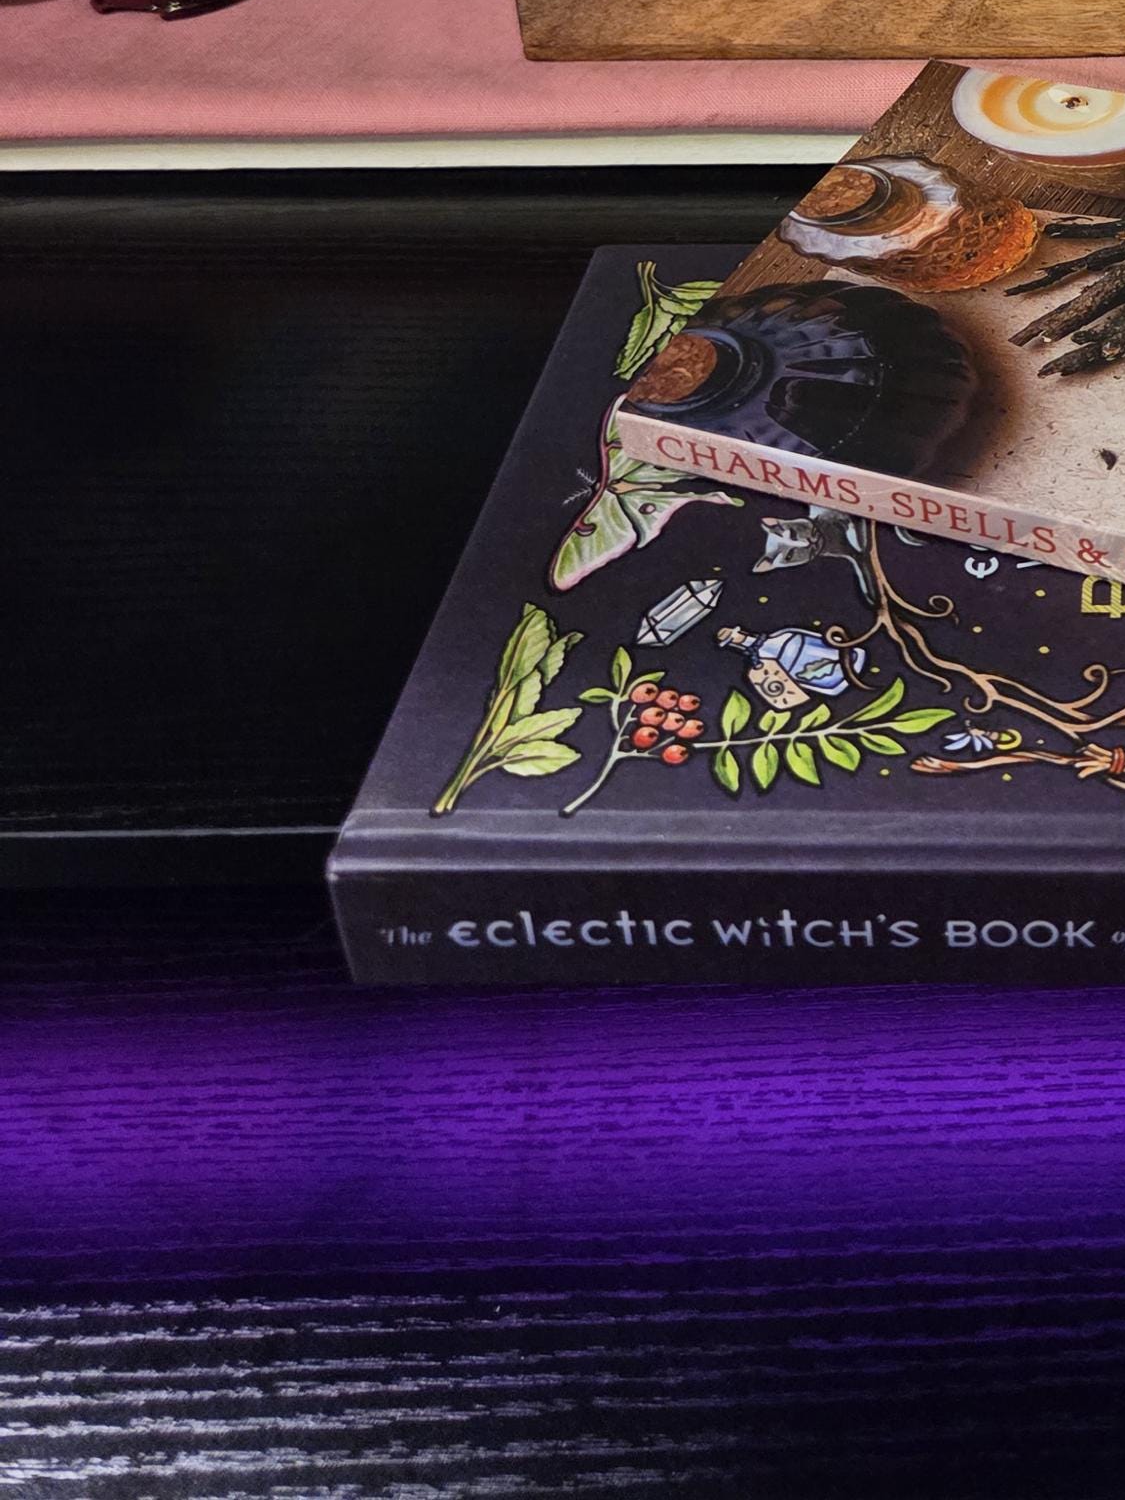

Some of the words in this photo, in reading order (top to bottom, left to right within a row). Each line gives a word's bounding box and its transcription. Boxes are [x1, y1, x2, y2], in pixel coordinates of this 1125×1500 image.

[655, 434, 876, 513] CHARMS,
[892, 490, 1058, 555] SPELLS
[1076, 537, 1112, 569] &
[379, 925, 433, 947] The
[944, 919, 1098, 949] BOOK
